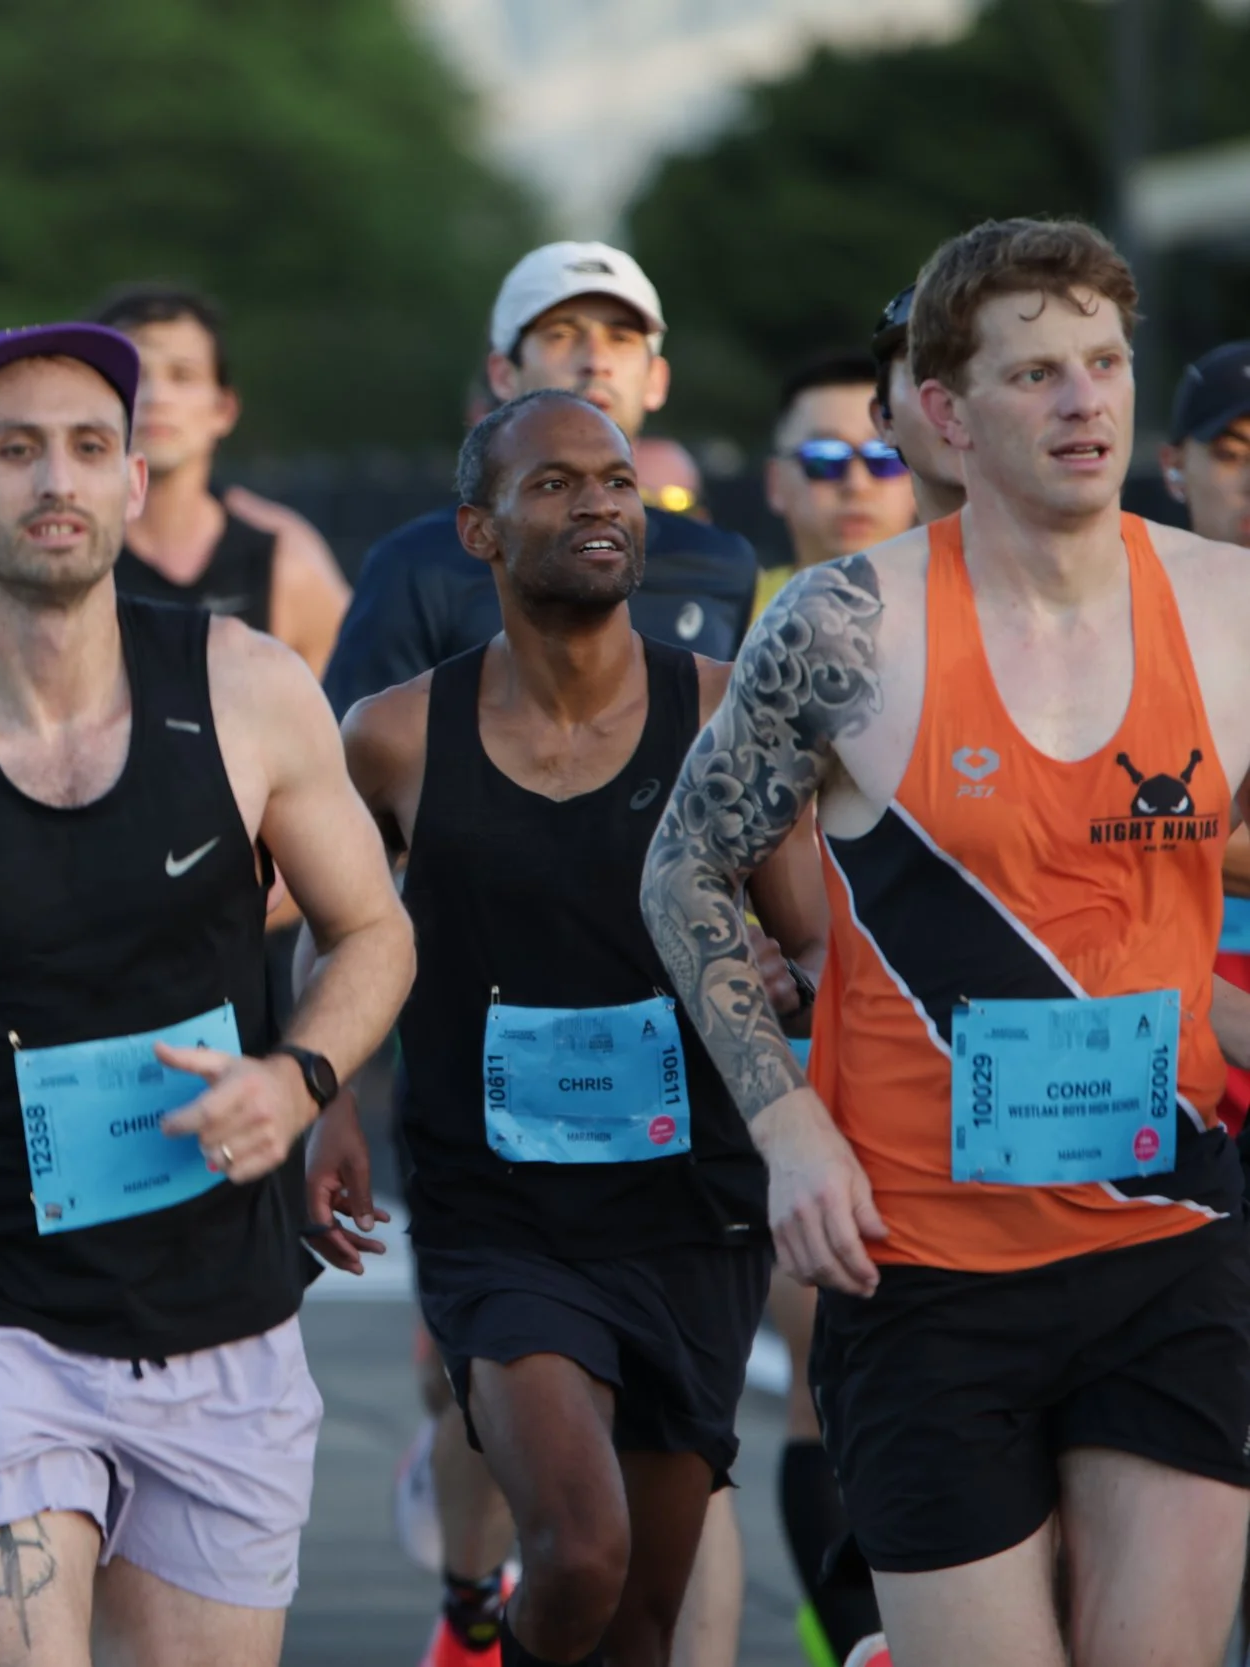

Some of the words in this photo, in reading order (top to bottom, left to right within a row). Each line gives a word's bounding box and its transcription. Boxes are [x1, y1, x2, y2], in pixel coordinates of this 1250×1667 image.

[1090, 821, 1154, 844] NIGHT
[1163, 819, 1218, 842] NINJAS
[488, 1054, 506, 1112] 10611
[558, 1076, 614, 1091] CHRIS
[662, 1044, 681, 1106] 10611
[972, 1054, 992, 1128] 10029
[1047, 1080, 1111, 1100] CONOR
[1152, 1045, 1169, 1119] 10029
[26, 1104, 53, 1179] 12358
